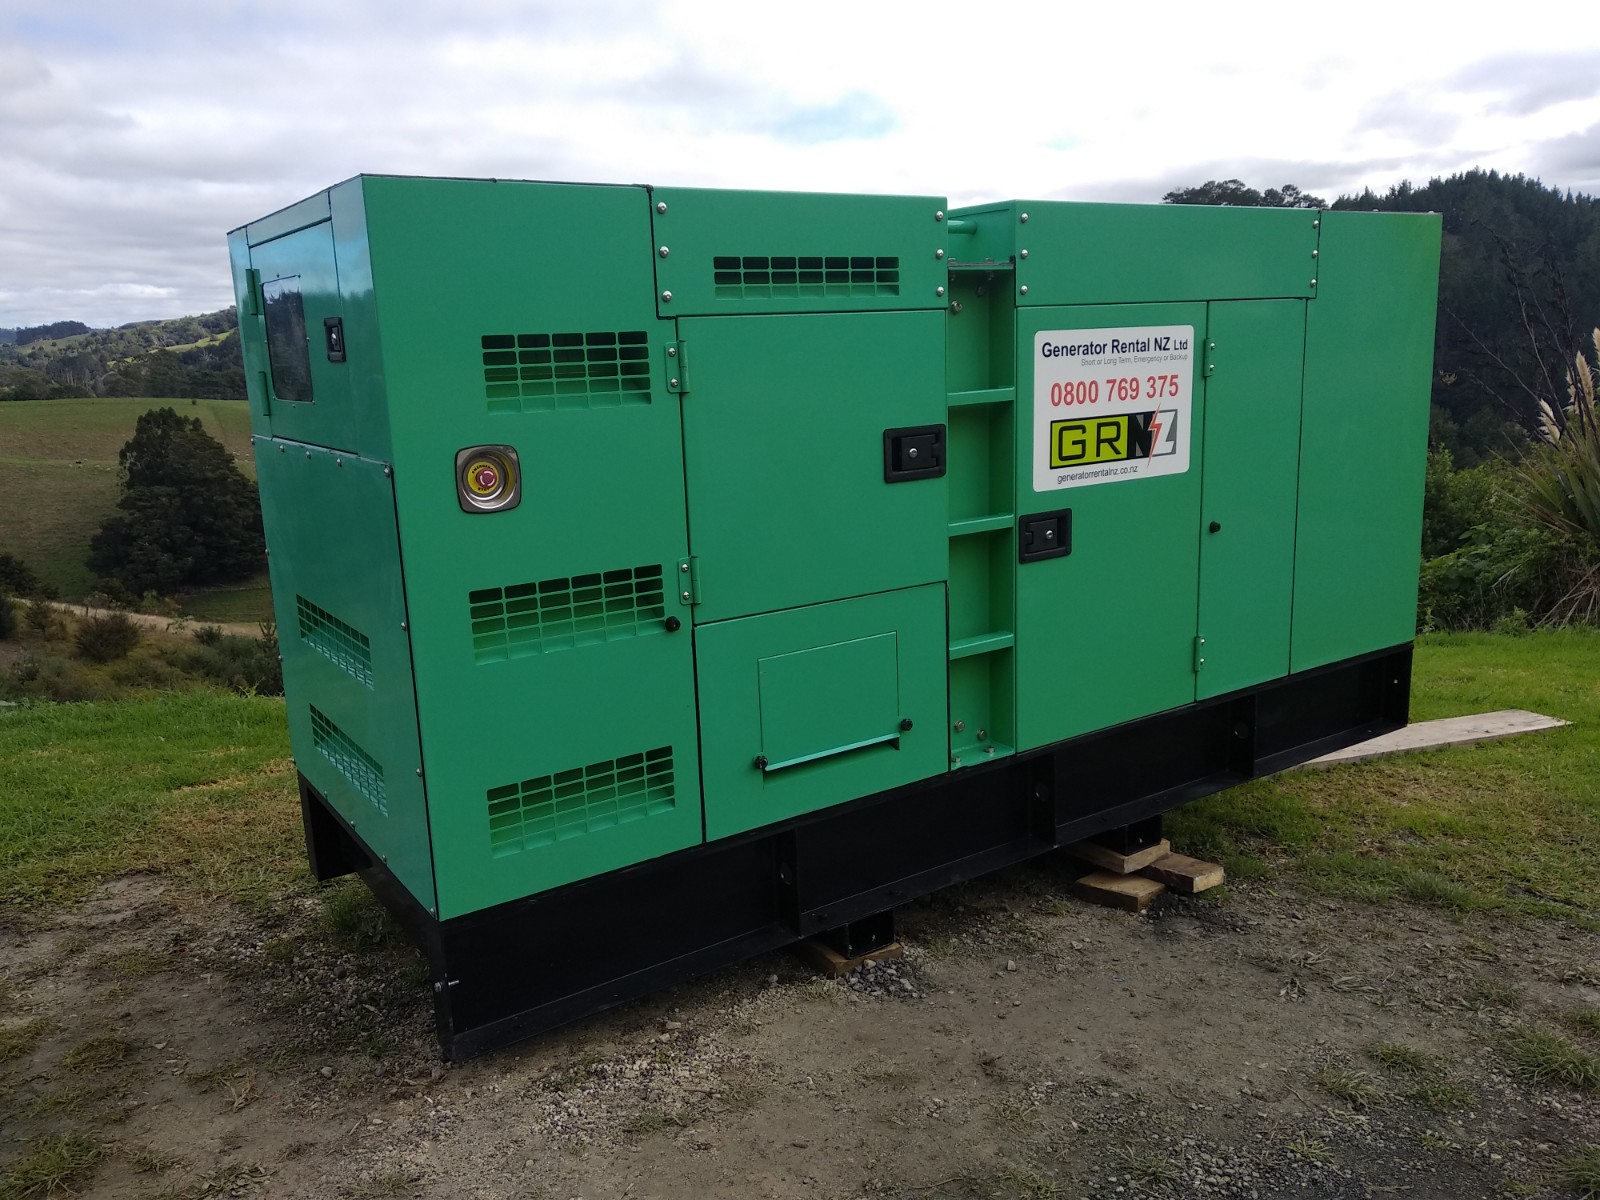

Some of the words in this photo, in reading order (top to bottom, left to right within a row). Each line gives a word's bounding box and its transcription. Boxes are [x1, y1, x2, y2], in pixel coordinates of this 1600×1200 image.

[1041, 341, 1108, 358] Generator
[1111, 337, 1150, 354] Rental
[1154, 336, 1171, 352] NZ
[1173, 338, 1188, 351] Ltd
[1081, 358, 1096, 366] Short
[1103, 357, 1118, 366] Long
[1133, 354, 1163, 364] Emergency
[1169, 353, 1188, 362] Backup
[1050, 379, 1099, 407] 0800
[1106, 376, 1140, 402] 769
[1146, 374, 1179, 399] 375
[1057, 464, 1139, 485] generatorrentalnz.co.nz
